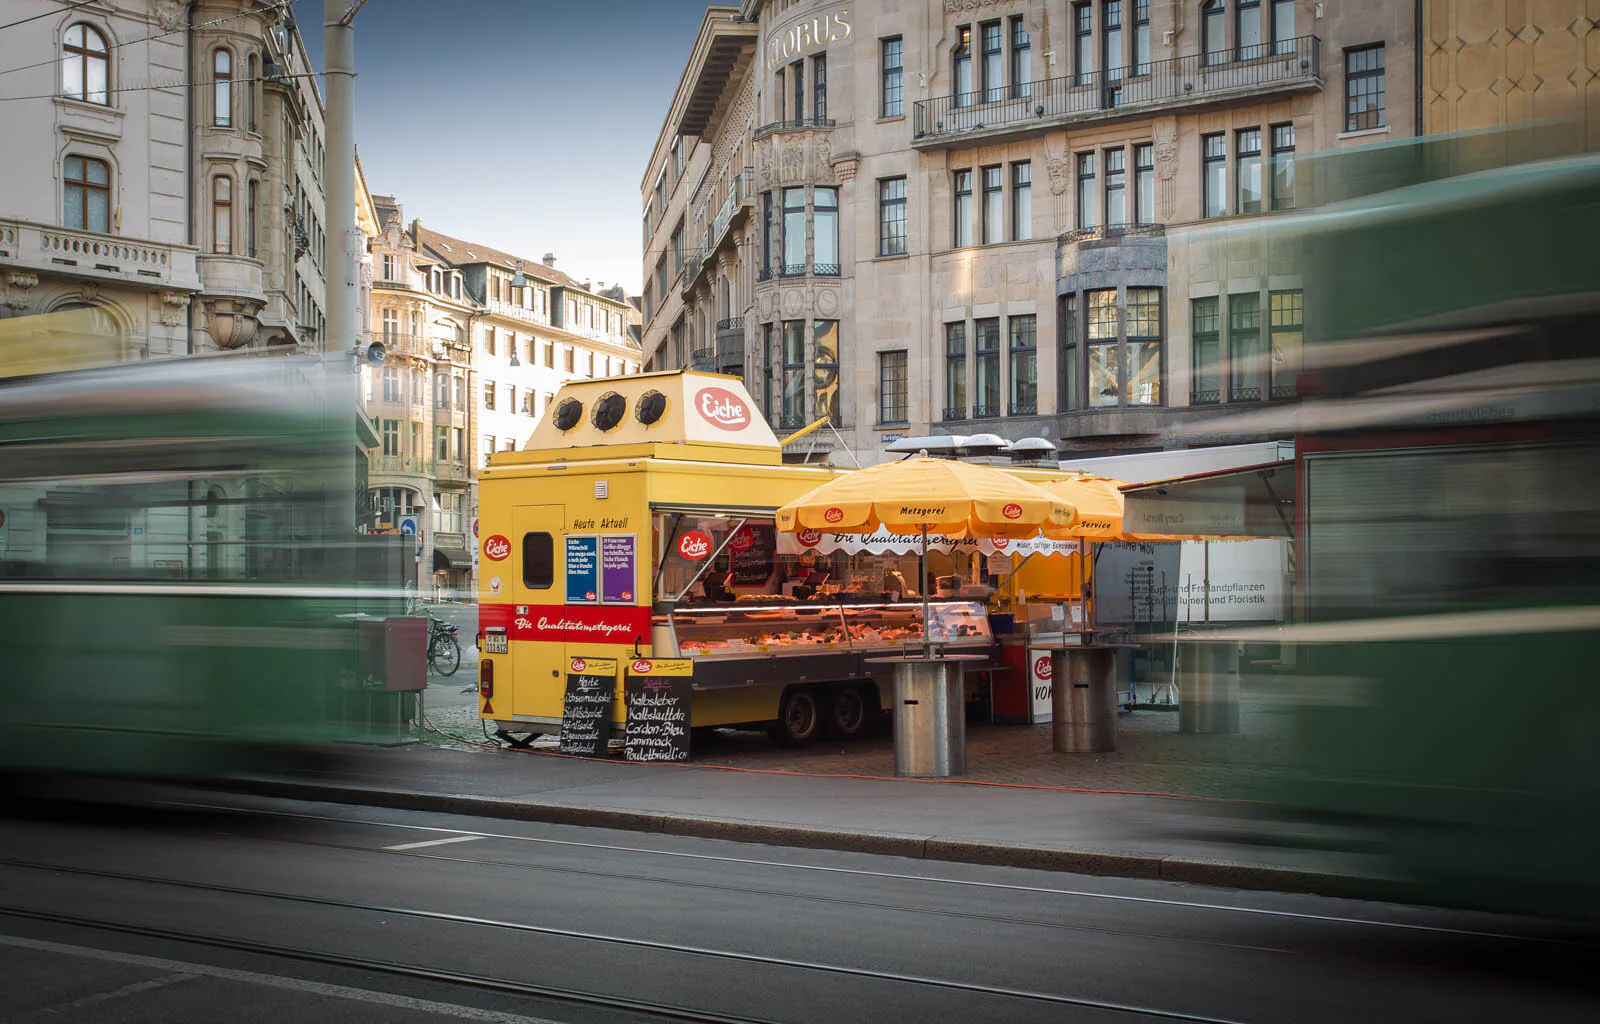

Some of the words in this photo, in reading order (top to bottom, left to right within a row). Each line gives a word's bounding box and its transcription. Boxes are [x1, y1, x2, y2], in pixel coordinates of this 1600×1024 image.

[701, 392, 746, 425] Eiche
[901, 506, 945, 516] Metzgerei
[573, 519, 595, 529] Heute
[600, 517, 629, 529] Aktuell
[1080, 520, 1111, 529] Service
[486, 538, 509, 559] Eiche
[681, 536, 708, 556] Eiche
[1228, 595, 1265, 604] Floristik
[514, 618, 532, 630] Die
[630, 691, 679, 706] Kalbsleber
[626, 721, 685, 736] Cordon-Bleu
[625, 736, 672, 747] Lammrack
